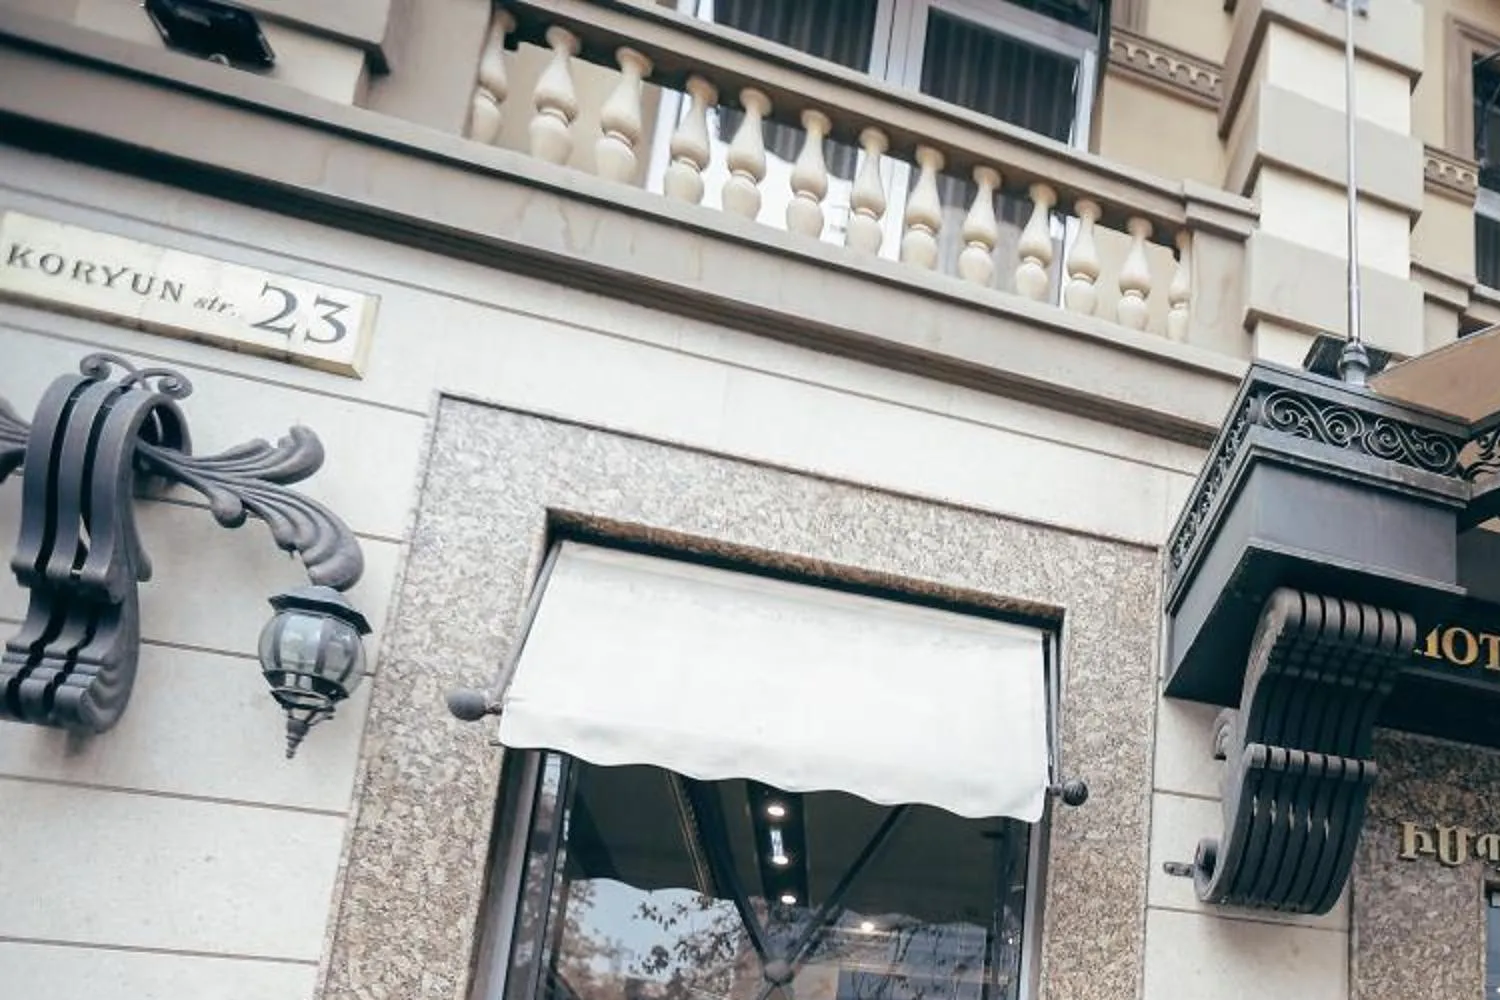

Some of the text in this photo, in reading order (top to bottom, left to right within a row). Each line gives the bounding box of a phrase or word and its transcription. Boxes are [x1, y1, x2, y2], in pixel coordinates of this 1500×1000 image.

[6, 243, 350, 344] KORYUN str. 23
